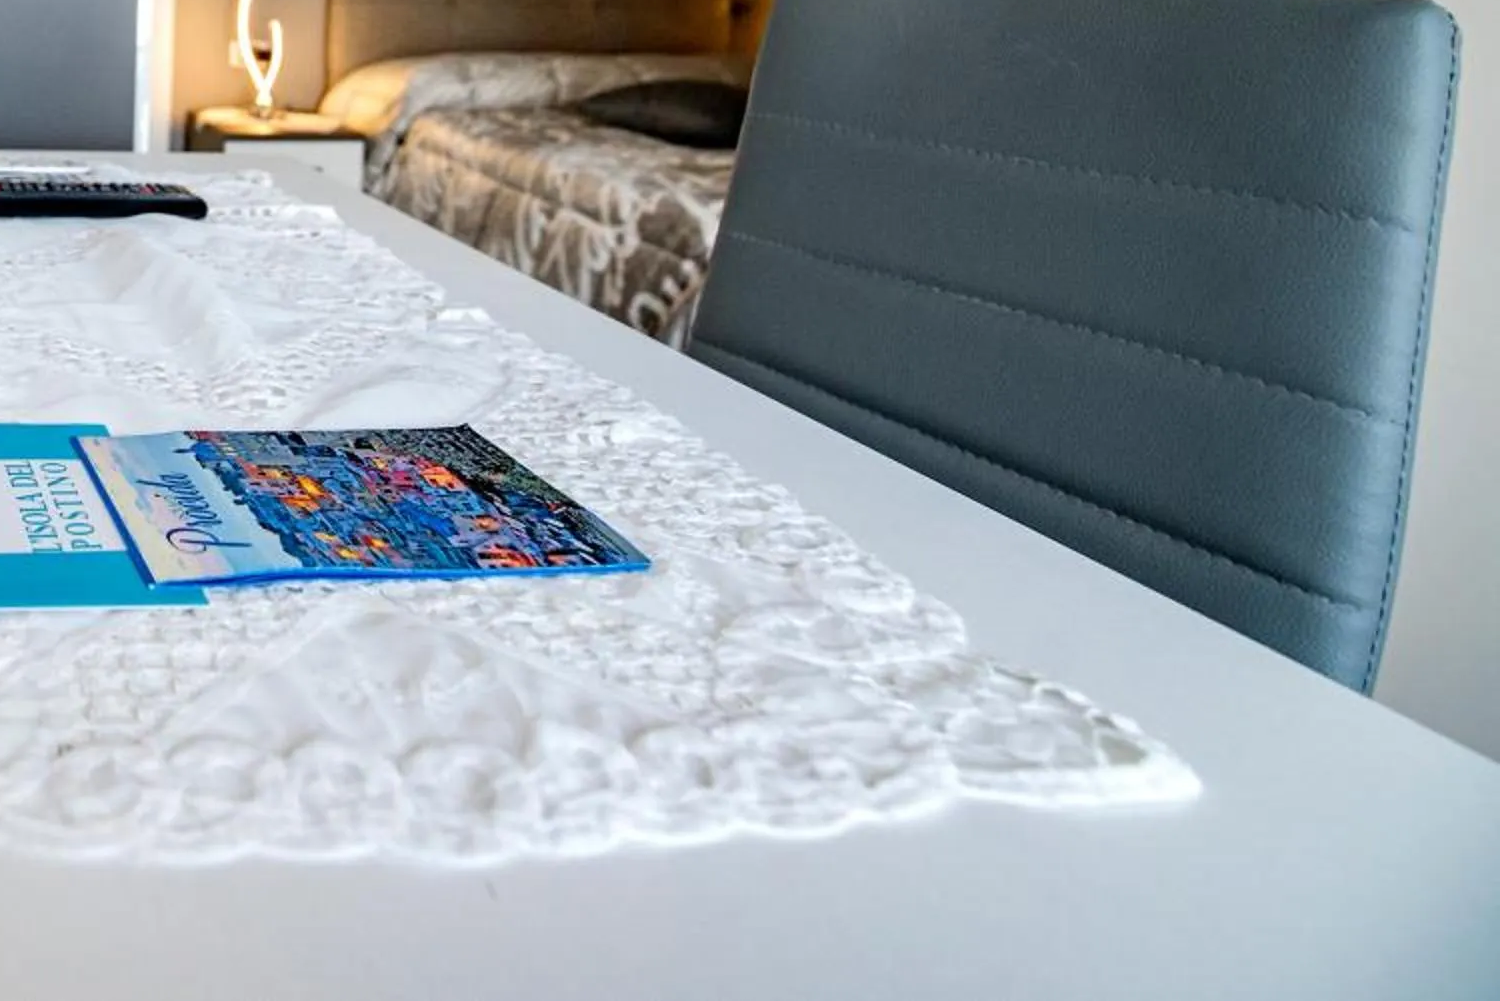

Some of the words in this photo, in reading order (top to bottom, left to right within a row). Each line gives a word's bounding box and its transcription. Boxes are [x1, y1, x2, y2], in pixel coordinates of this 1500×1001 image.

[4, 460, 39, 488] DEL
[40, 462, 102, 550] POSTINO
[16, 492, 63, 554] L'ISOLA
[136, 472, 252, 554] Procida
